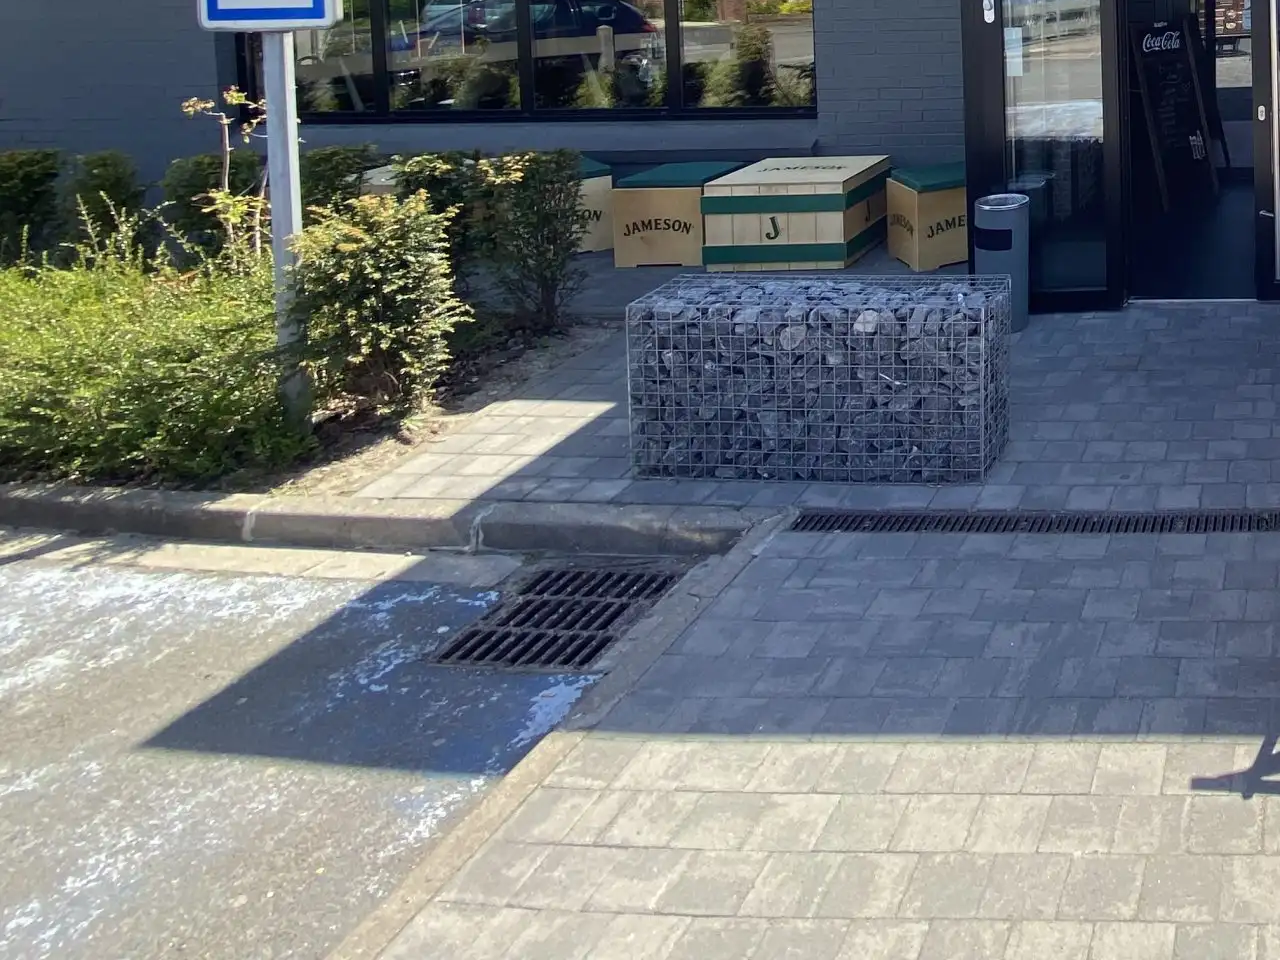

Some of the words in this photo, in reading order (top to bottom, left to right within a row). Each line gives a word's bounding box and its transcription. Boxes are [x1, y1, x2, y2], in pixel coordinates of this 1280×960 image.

[623, 216, 693, 237] JAMESON
[765, 215, 781, 241] J
[927, 214, 966, 239] JAME
